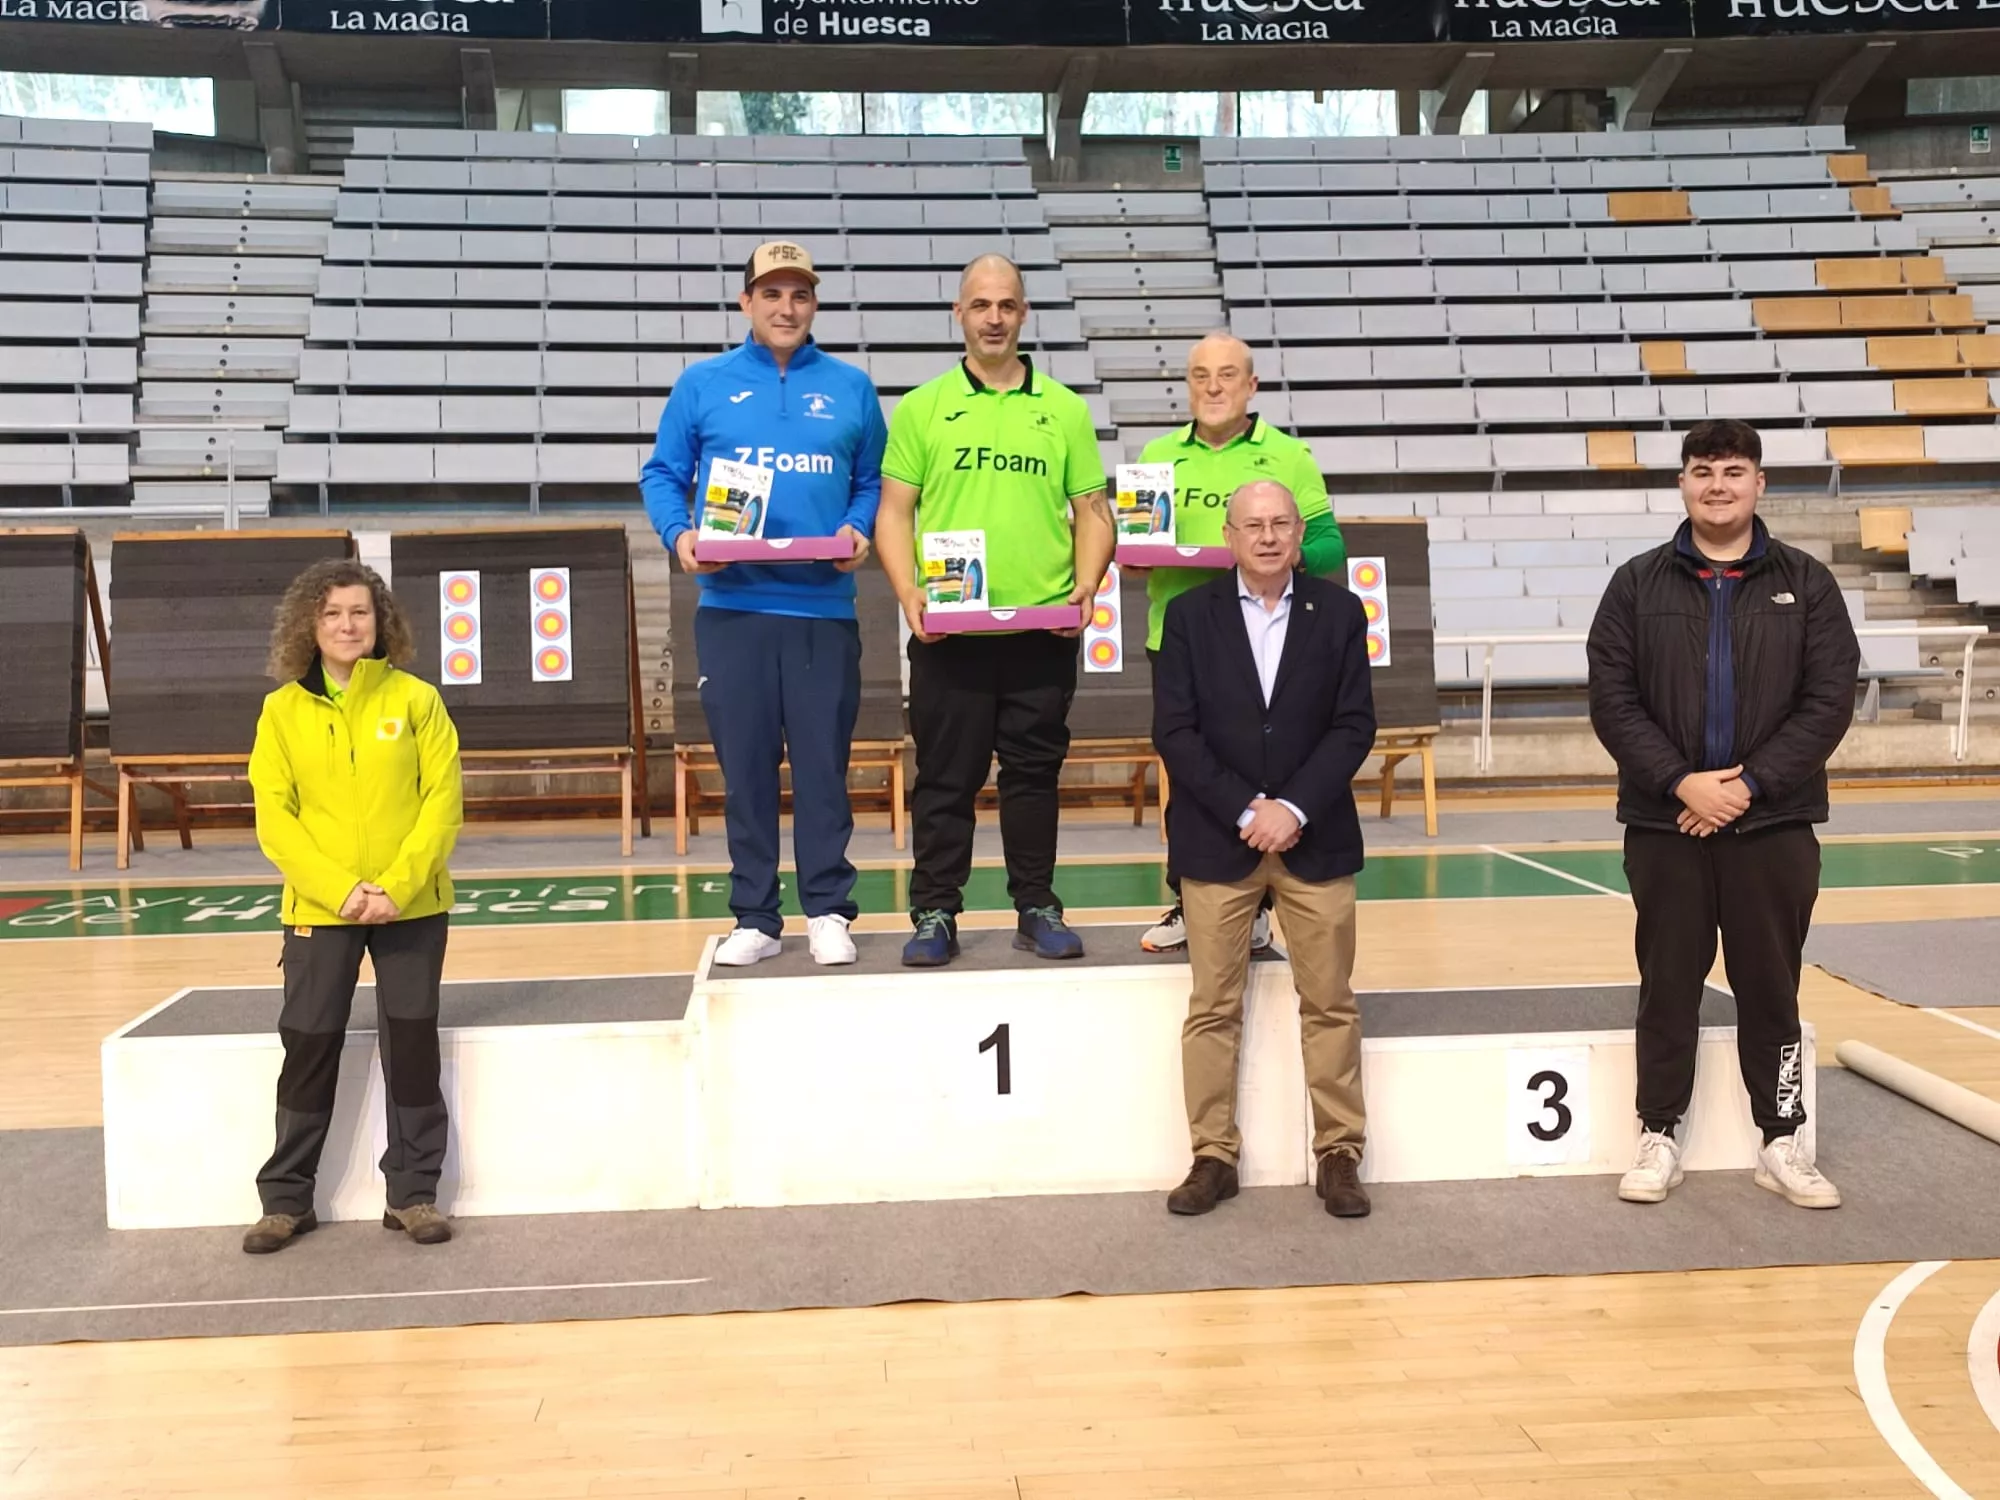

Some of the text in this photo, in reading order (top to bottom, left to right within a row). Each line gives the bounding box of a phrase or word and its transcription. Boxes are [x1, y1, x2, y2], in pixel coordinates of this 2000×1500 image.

[773, 12, 931, 37] de Huesca
[9, 909, 140, 926] de
[978, 1023, 1011, 1095] 1
[1526, 1070, 1573, 1142] 3
